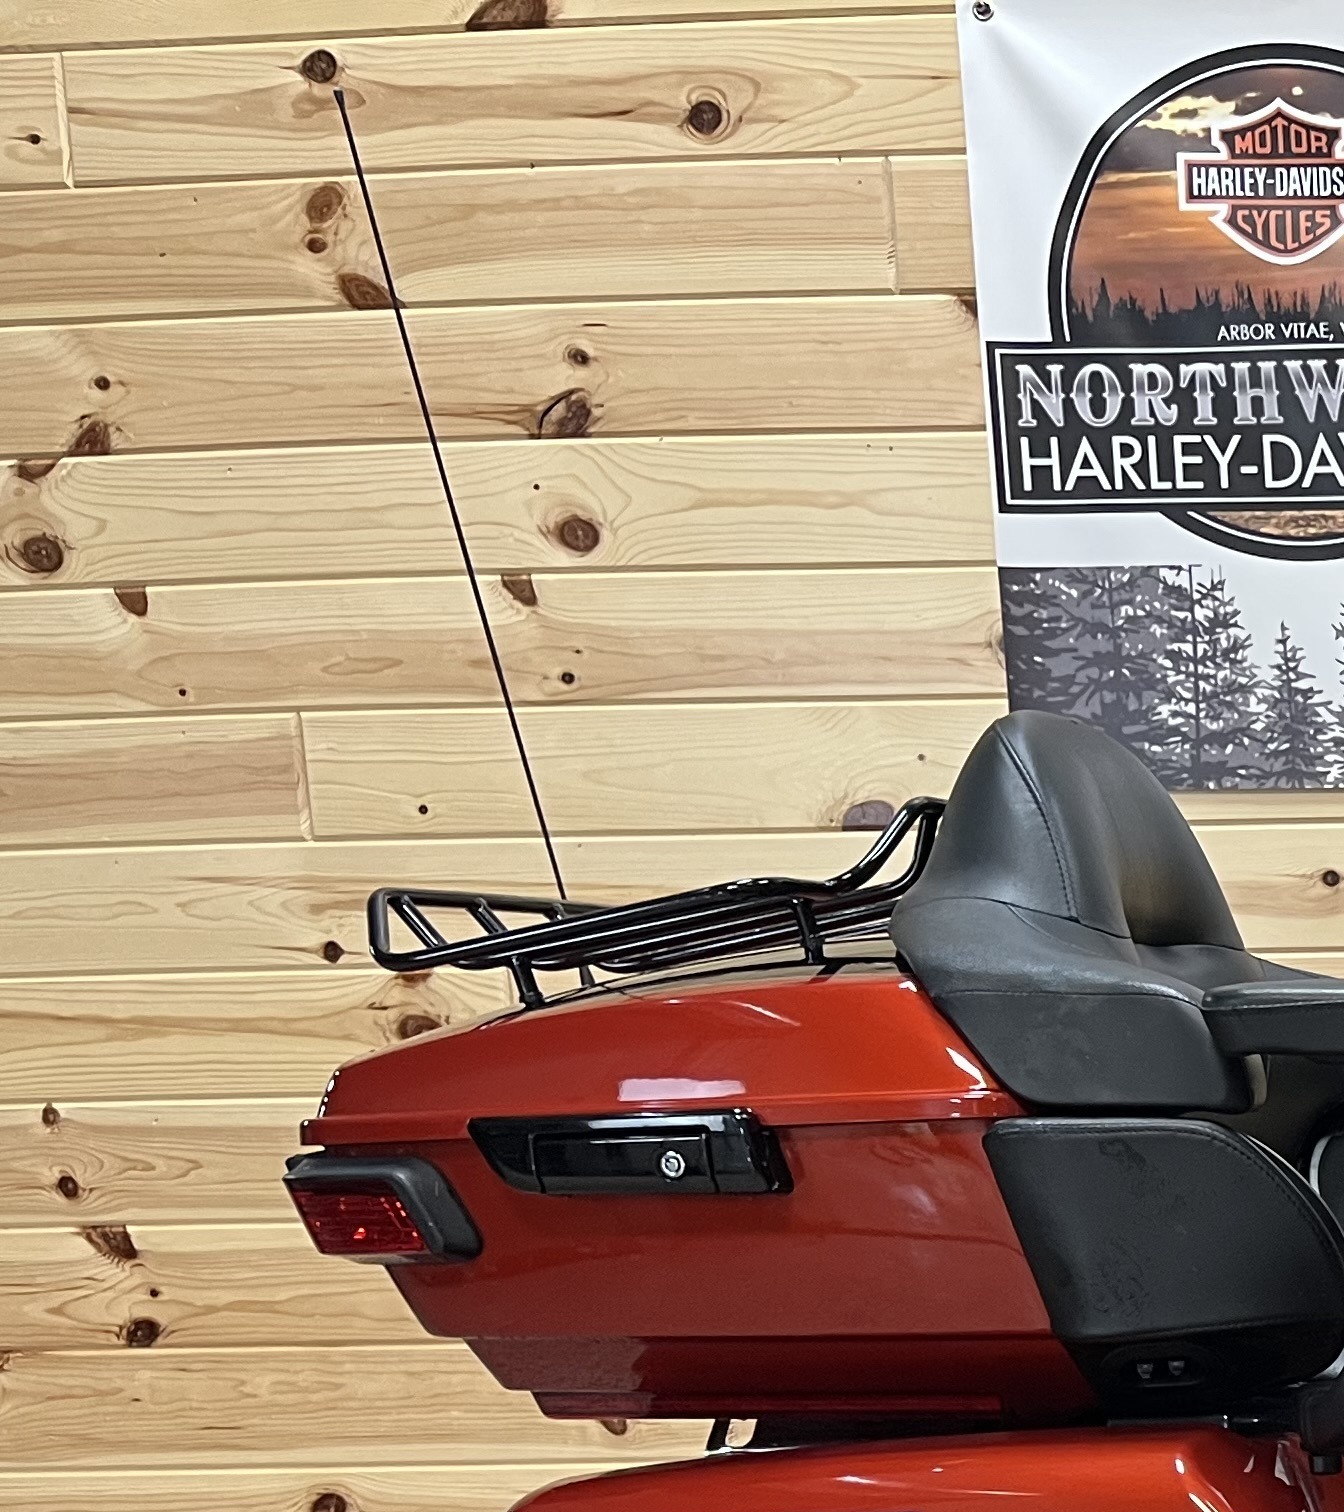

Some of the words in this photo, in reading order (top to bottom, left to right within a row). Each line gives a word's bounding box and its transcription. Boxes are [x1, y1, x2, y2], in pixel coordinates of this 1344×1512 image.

[1234, 116, 1328, 154] MOTOR
[1236, 209, 1331, 250] CYCLES
[1217, 323, 1276, 342] ARBOR
[1280, 321, 1335, 342] VITAE,
